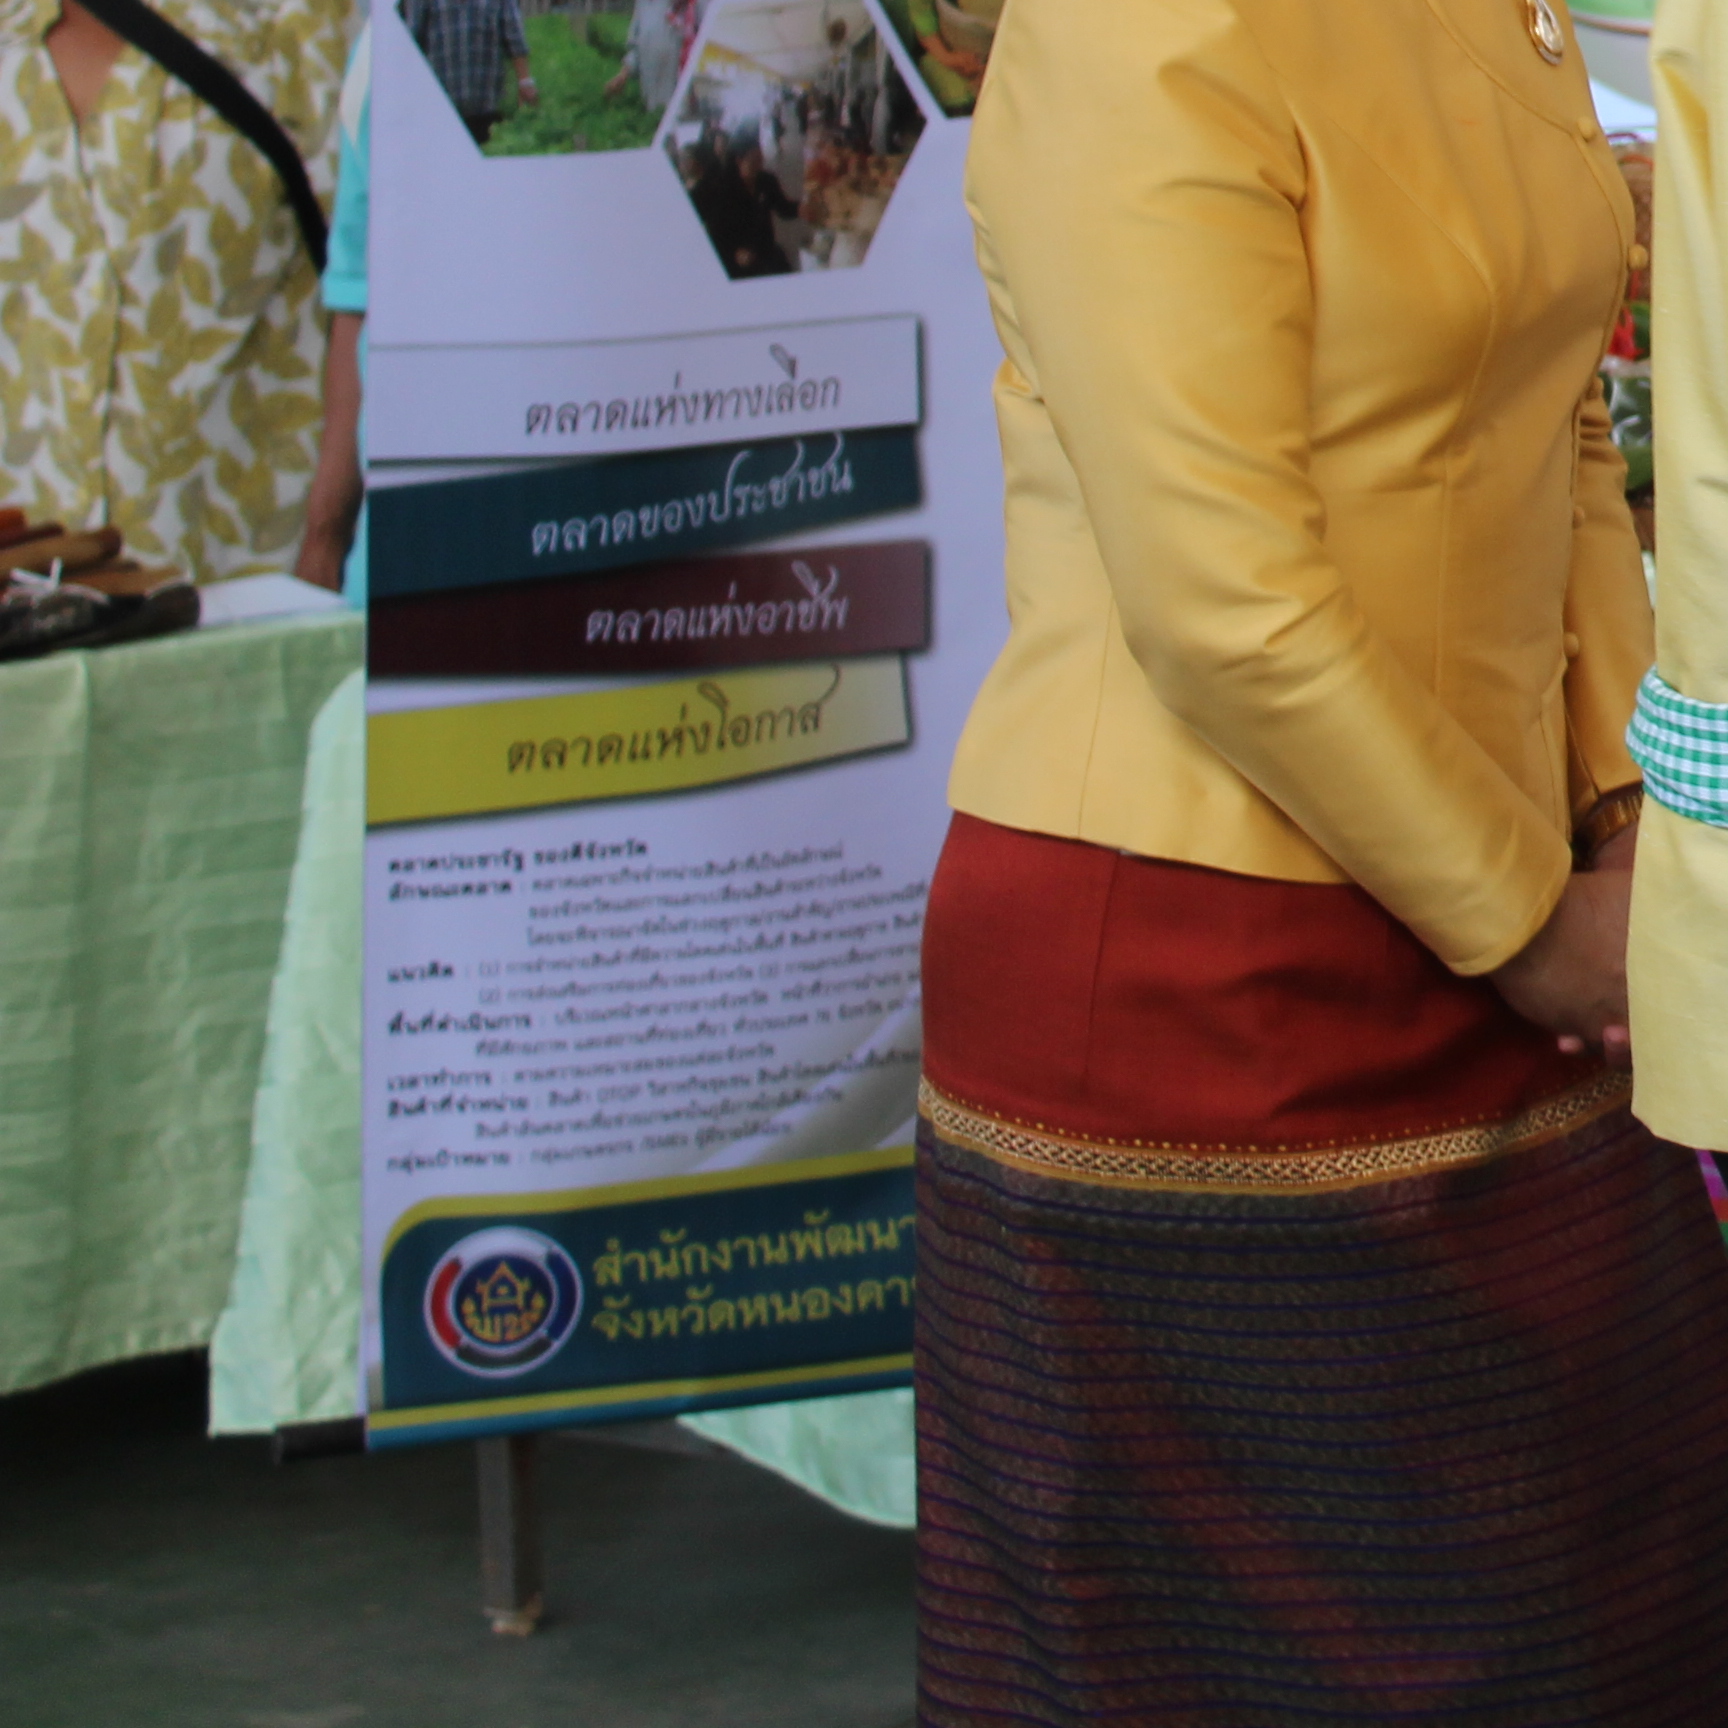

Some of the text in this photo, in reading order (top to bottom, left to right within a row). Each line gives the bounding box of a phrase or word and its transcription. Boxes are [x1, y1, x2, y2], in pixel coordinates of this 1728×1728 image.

[524, 343, 842, 436] ตลาดแห่งทางเลือก
[530, 431, 855, 557] ตลาดของประชาชน
[584, 560, 848, 645] ตลาดแห่งอาชีพ
[506, 664, 842, 775] ตลาดแห่งโอกาส
[590, 1275, 917, 1342] จังหวัดหนองคา
